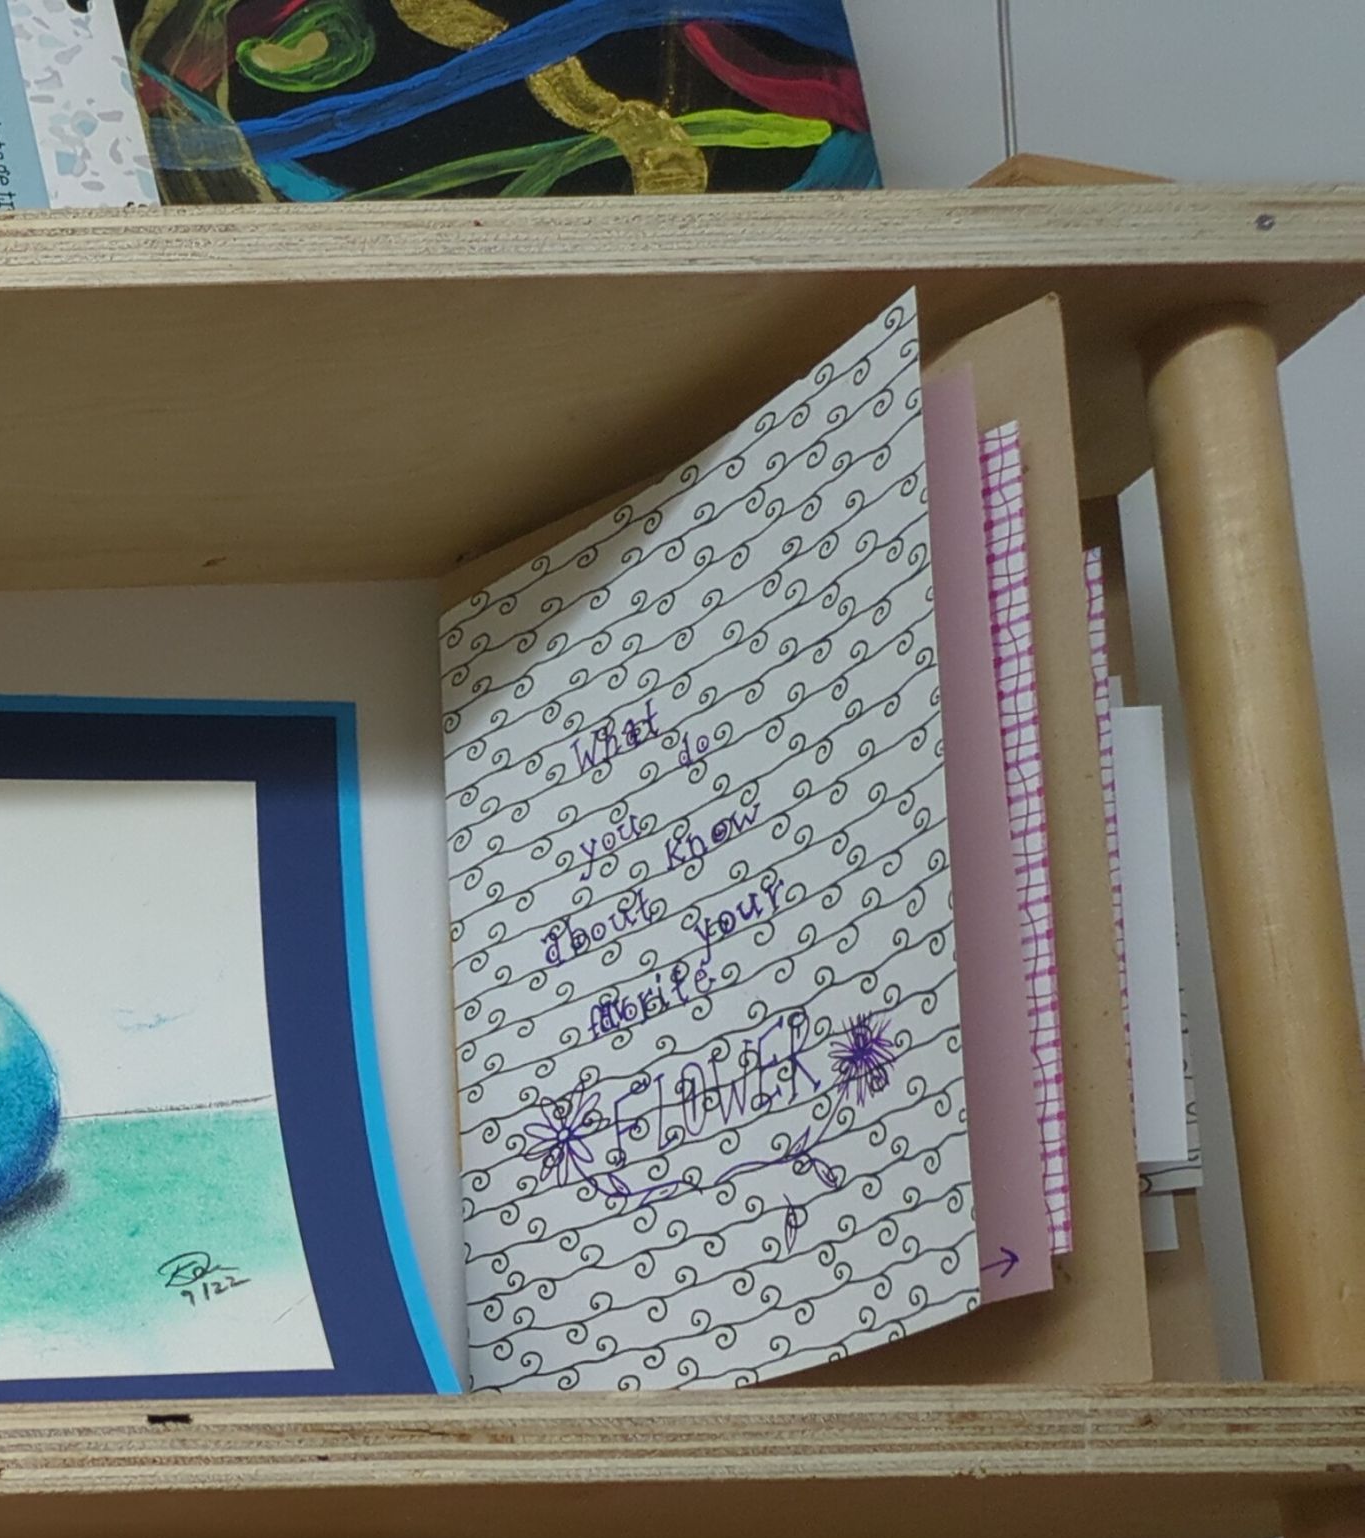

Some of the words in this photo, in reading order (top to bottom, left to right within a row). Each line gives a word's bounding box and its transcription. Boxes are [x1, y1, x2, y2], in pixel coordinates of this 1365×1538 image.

[570, 698, 660, 775] What
[678, 732, 710, 768] do
[580, 814, 642, 882] you
[540, 886, 655, 968] about
[693, 878, 784, 967] your
[610, 1010, 822, 1168] FLOWER
